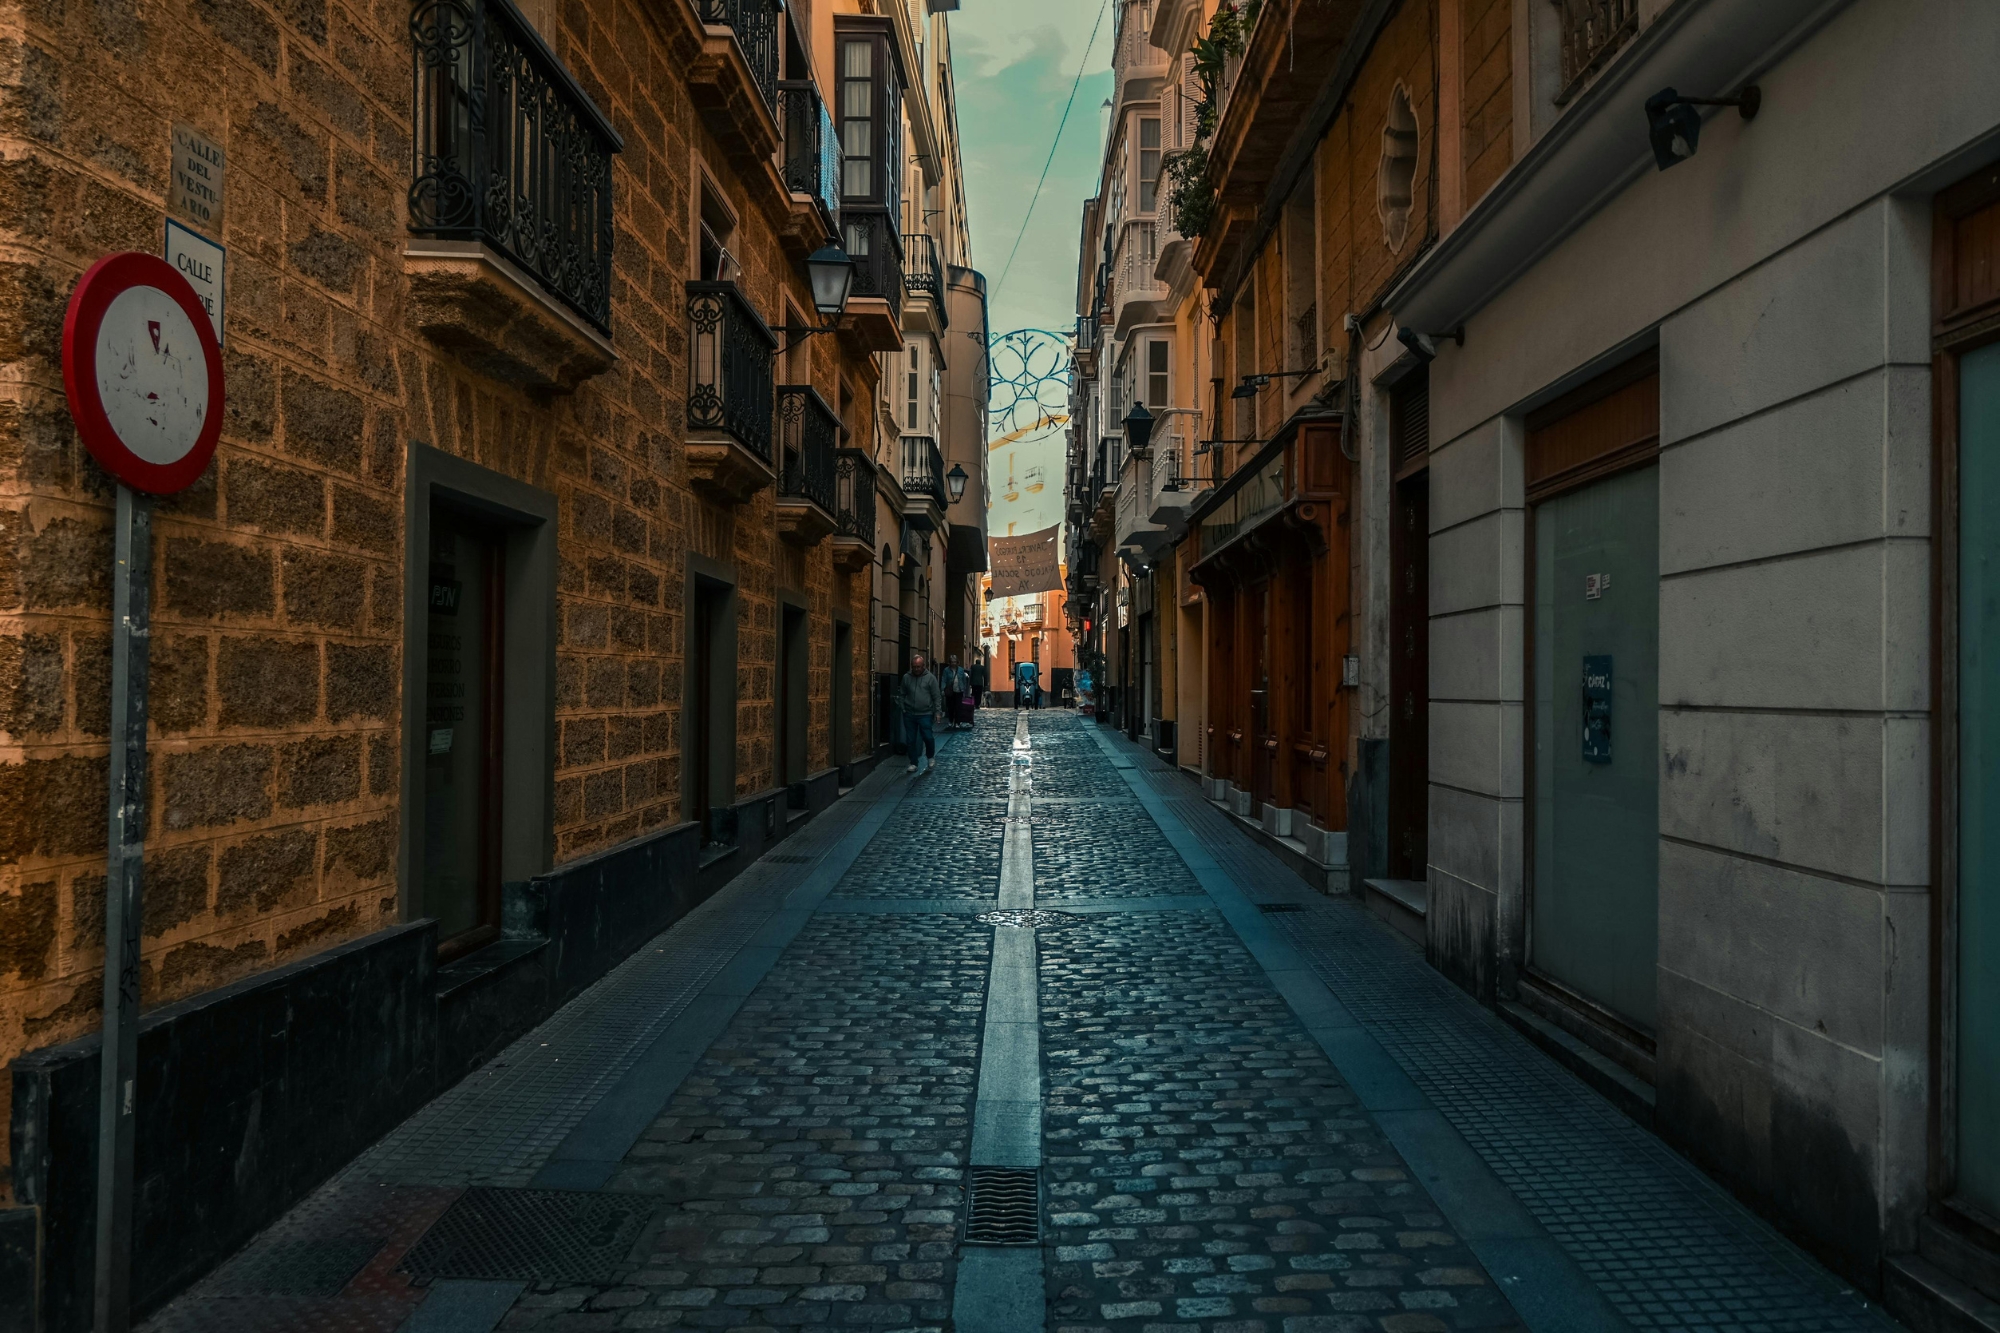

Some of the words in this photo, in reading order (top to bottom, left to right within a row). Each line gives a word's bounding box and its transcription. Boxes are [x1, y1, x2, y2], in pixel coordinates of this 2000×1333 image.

[178, 131, 220, 168] CALLE
[187, 156, 211, 181] DEL
[178, 170, 219, 204] VESTU-
[181, 195, 210, 221] ARIO
[177, 253, 213, 284] CALLE
[431, 585, 456, 607] PSN
[428, 634, 461, 651] EGUROS
